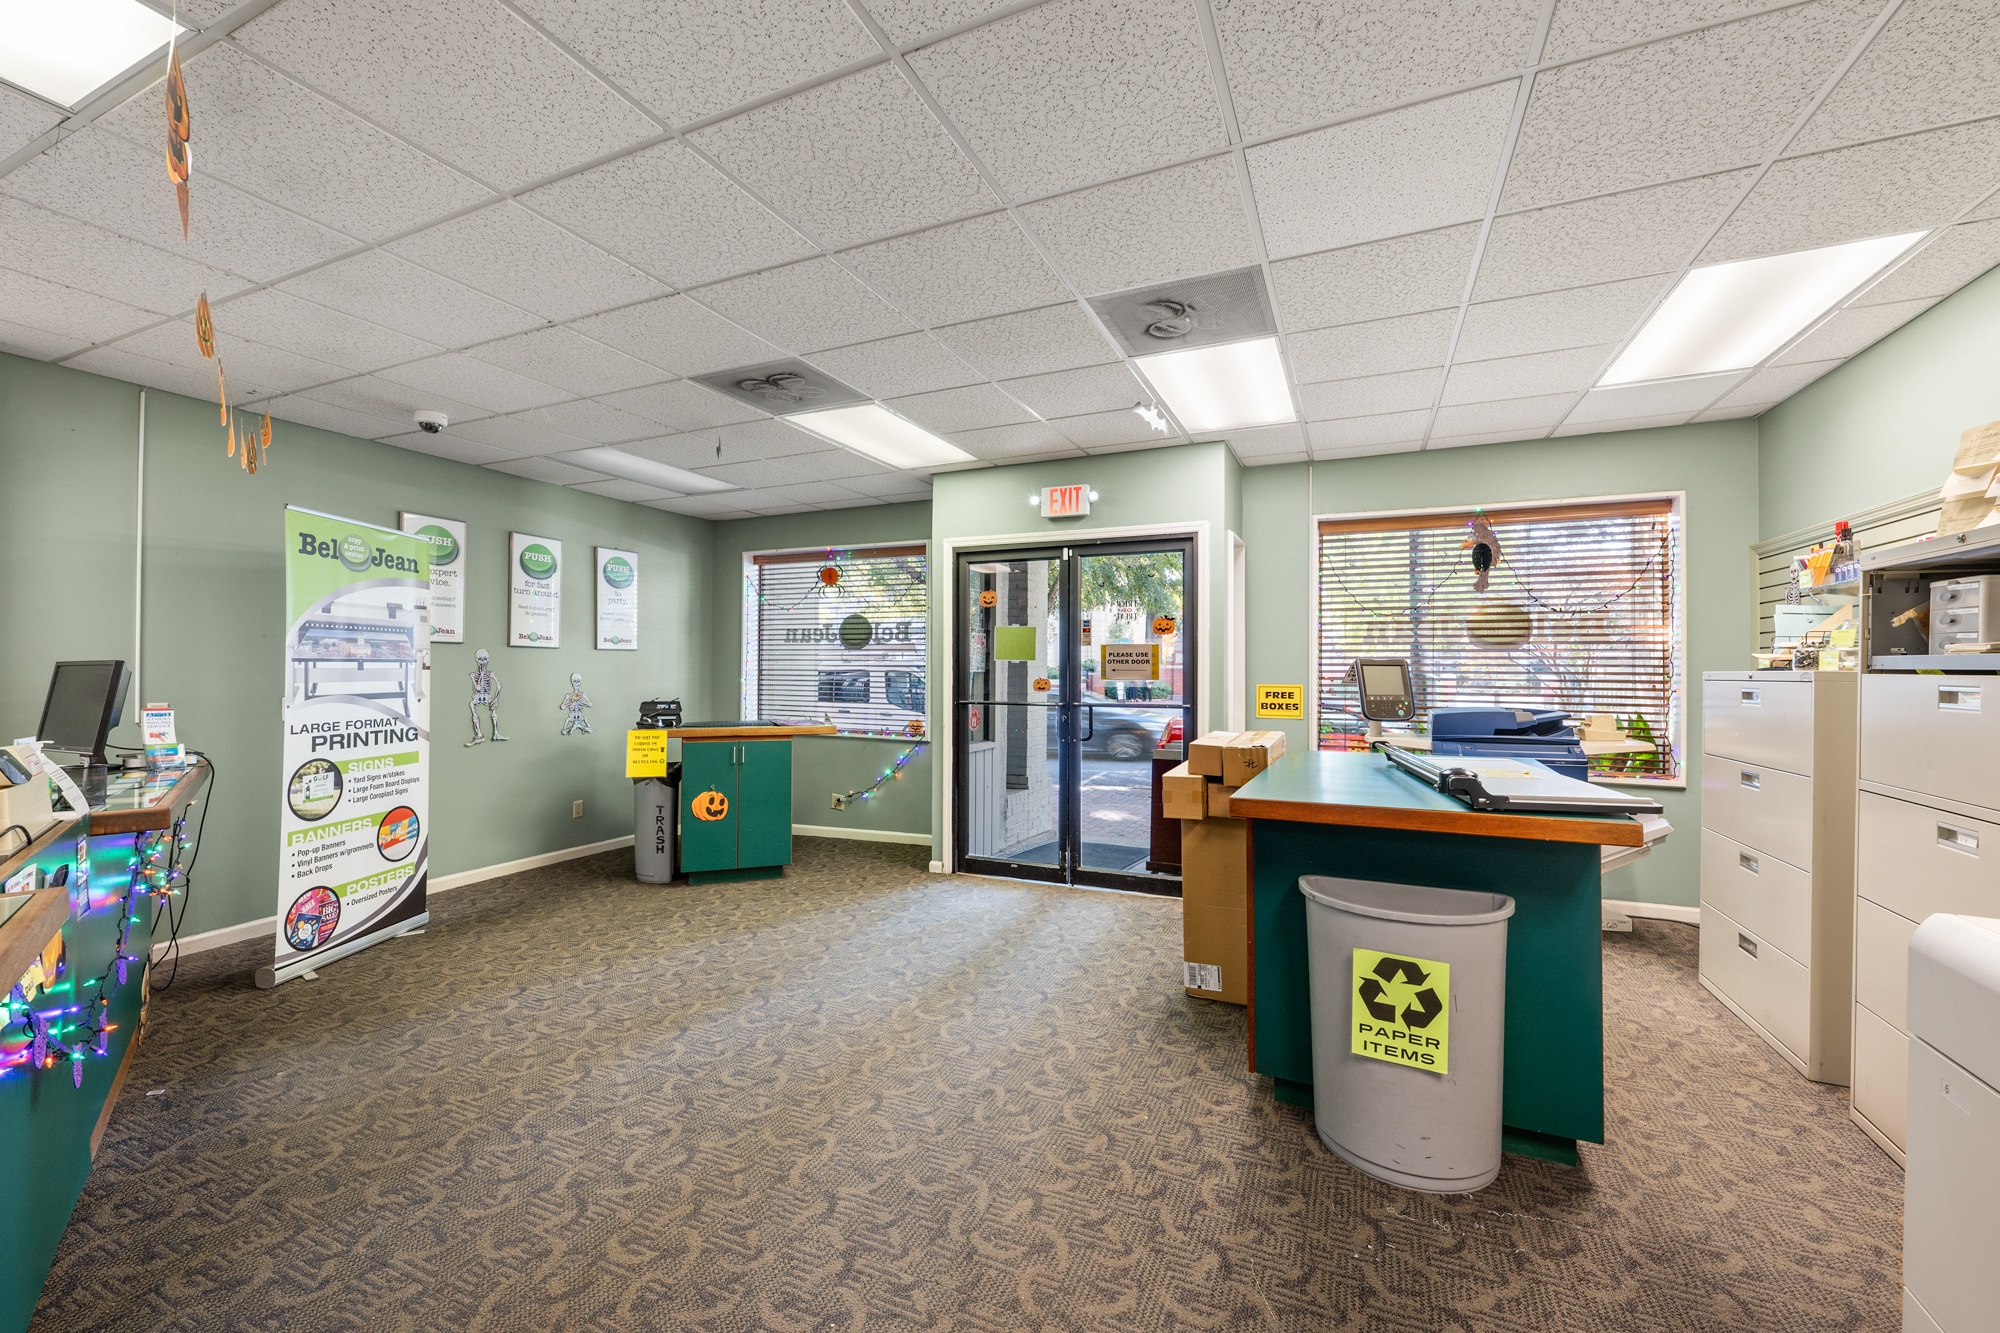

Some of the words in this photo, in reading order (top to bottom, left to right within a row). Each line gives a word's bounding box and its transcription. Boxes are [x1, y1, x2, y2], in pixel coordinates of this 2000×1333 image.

[1050, 486, 1082, 514] EXIT
[348, 537, 362, 545] copy
[349, 544, 365, 552] print
[299, 532, 339, 560] Bel
[371, 547, 419, 574] Jean
[345, 551, 365, 559] center
[525, 551, 552, 563] PUSH
[607, 564, 630, 573] PUSH
[525, 580, 536, 588] for
[536, 580, 550, 589] fast
[608, 597, 628, 606] party.
[436, 627, 455, 635] Jean
[1265, 691, 1294, 699] FREE
[1261, 702, 1299, 711] BOXES
[290, 721, 341, 735] LARGE
[345, 717, 399, 730] FORMAT
[311, 726, 419, 753] PRINTING
[348, 757, 394, 773] SIGNS
[353, 776, 365, 784] Yard
[366, 774, 381, 783] Signs
[382, 770, 405, 779] w/stakes
[353, 785, 368, 794] Large
[369, 783, 384, 792] Foam
[385, 780, 400, 789] Board
[401, 776, 420, 787] Displays
[353, 795, 368, 804] Large
[369, 790, 395, 803] Coroplast
[396, 787, 409, 797] Signs
[291, 818, 373, 846] BANNERS
[656, 805, 665, 854] TRASH
[297, 846, 320, 857] Pop-up
[321, 840, 346, 851] Banners
[297, 858, 313, 868] Vinyl
[314, 852, 338, 862] Banners
[339, 841, 374, 856] w/grommets
[297, 868, 313, 879] Back
[314, 864, 333, 875] Drops
[346, 865, 414, 896] POSTERS
[351, 892, 378, 906] Oversized
[378, 886, 398, 897] Posters
[301, 899, 316, 913] SALE
[322, 905, 337, 915] BIG
[1359, 1023, 1440, 1050] PAPER
[1364, 1040, 1435, 1065] ITEMS
[1945, 1084, 1950, 1094] 6
